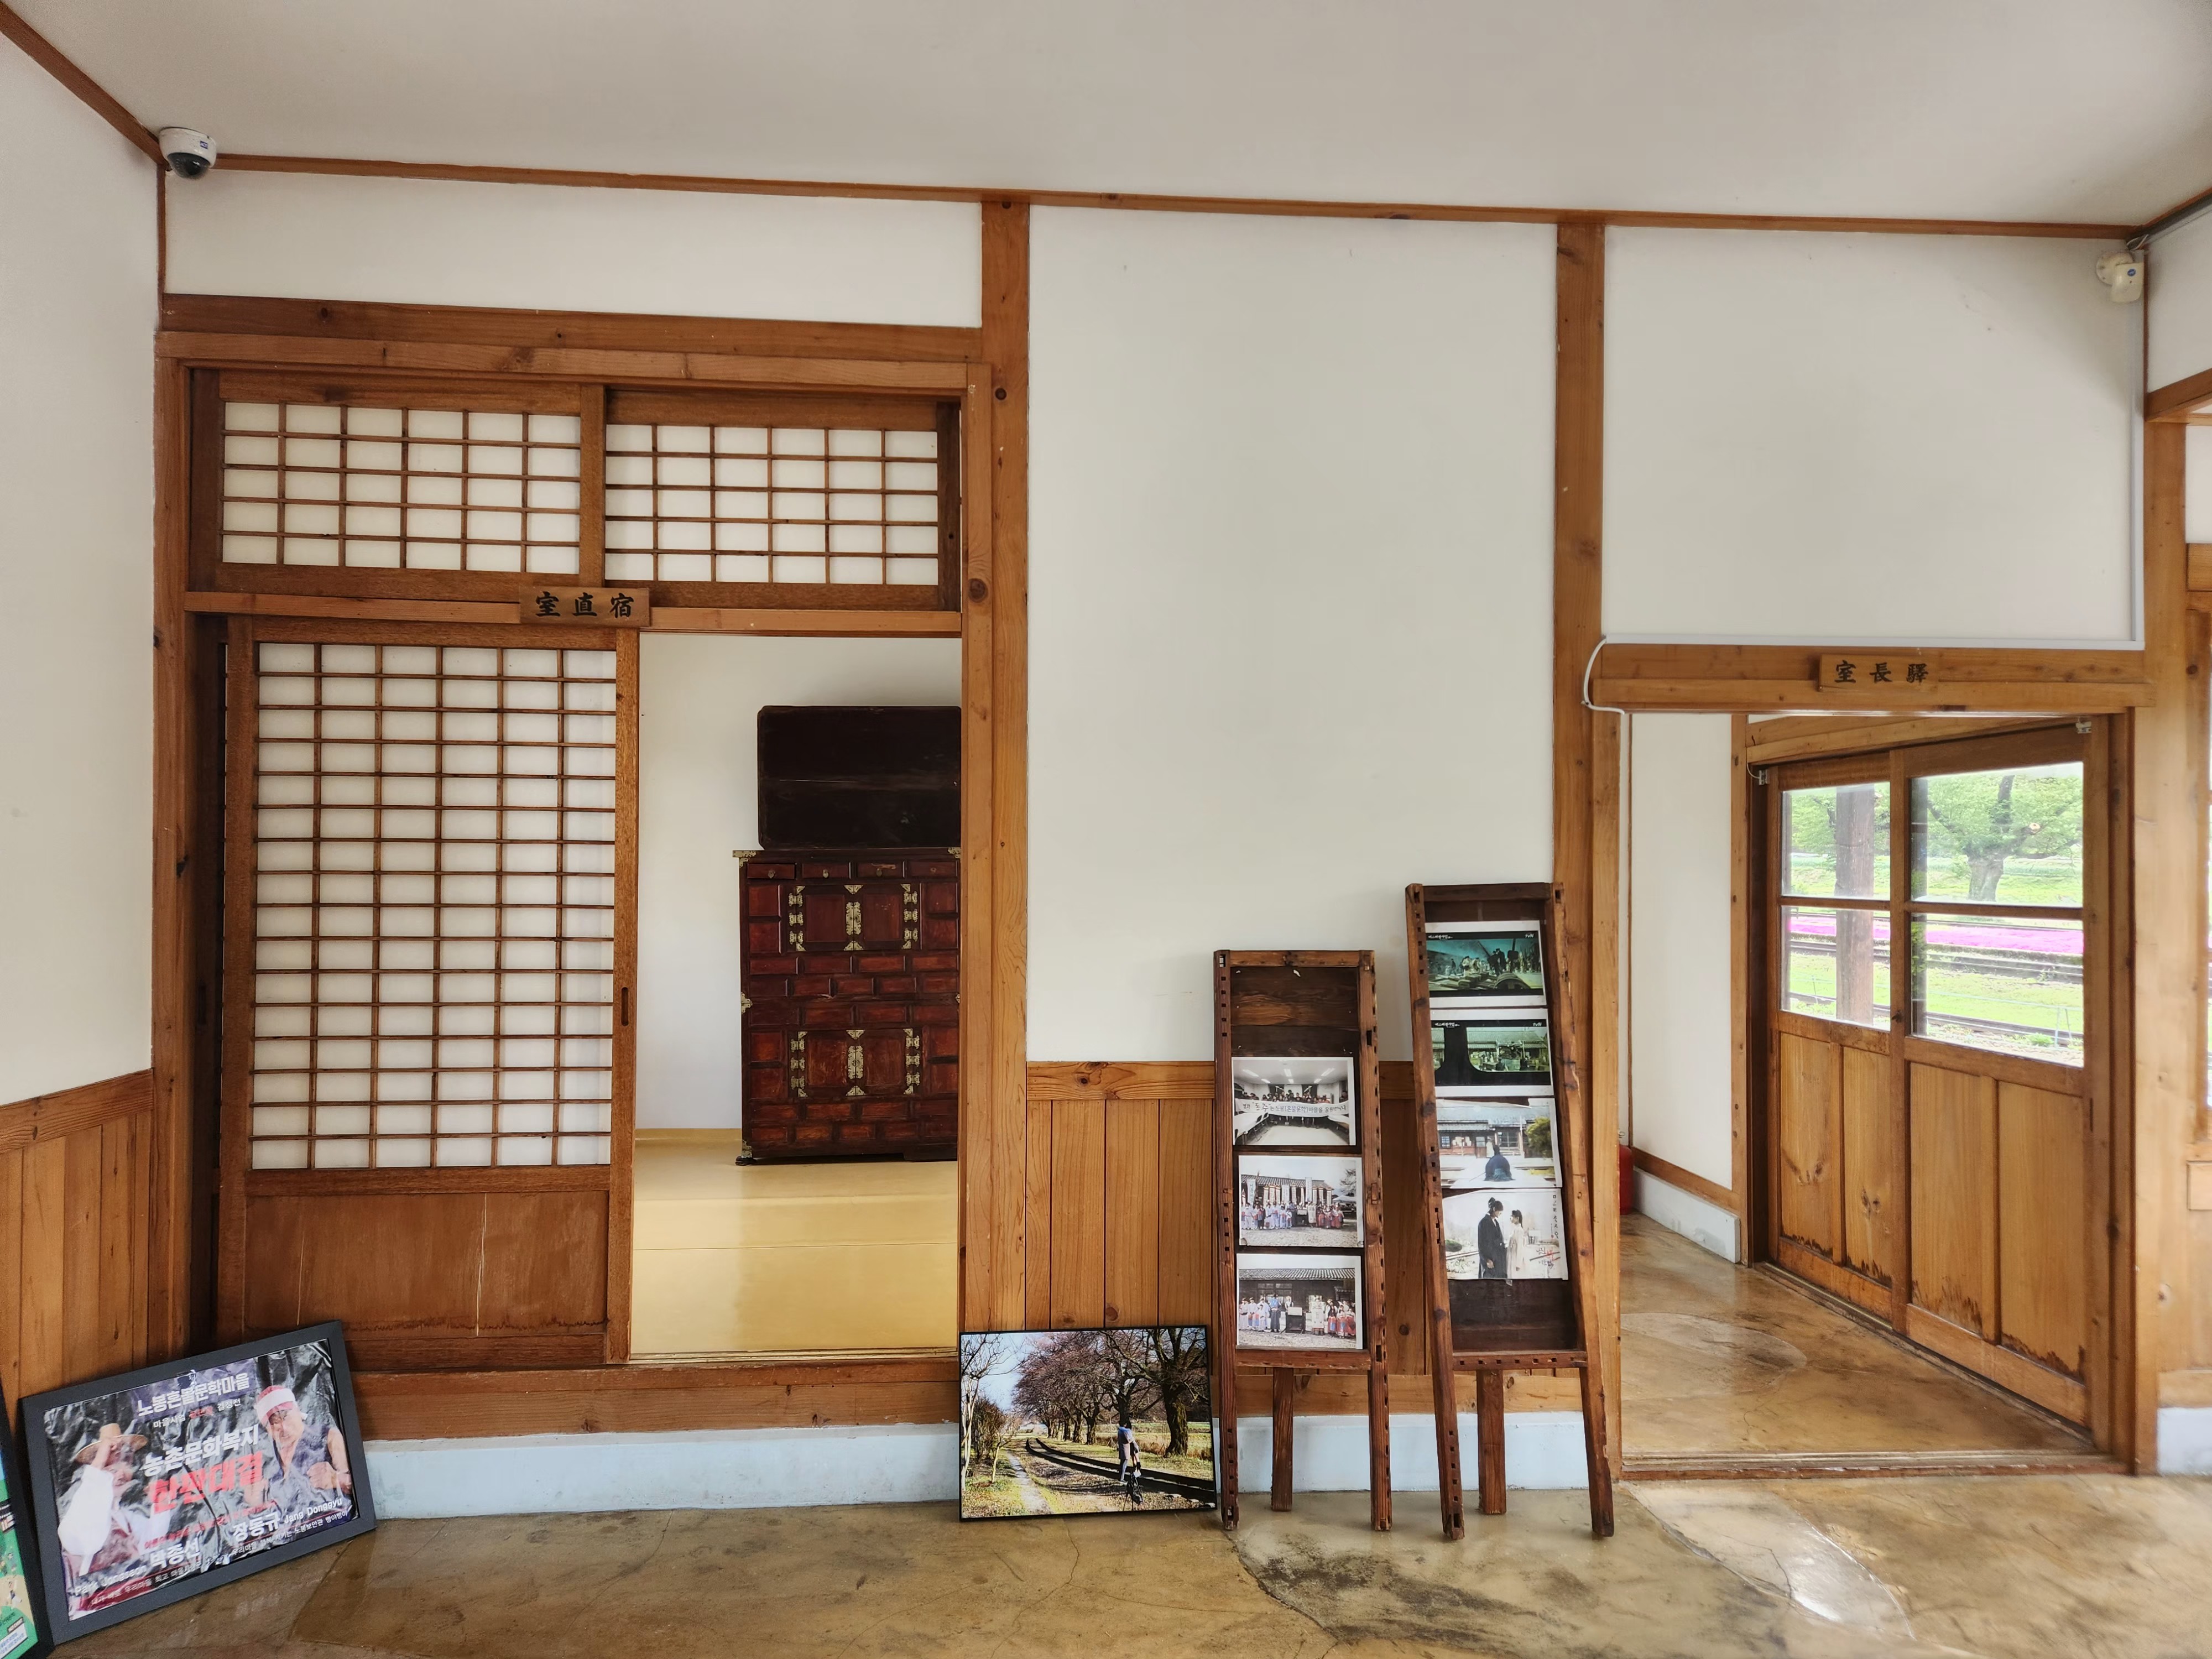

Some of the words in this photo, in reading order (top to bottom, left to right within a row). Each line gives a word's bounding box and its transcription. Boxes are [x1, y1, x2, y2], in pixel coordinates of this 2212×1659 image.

[138, 1373, 249, 1416] 노봉혼불문학마을
[153, 1415, 186, 1428] 마을사업
[141, 1423, 259, 1477] 농촌문화복지
[151, 1450, 263, 1514] 한판대결
[233, 1512, 281, 1542] 장동규
[284, 1511, 304, 1524] Jang
[307, 1498, 343, 1516] Donggyu
